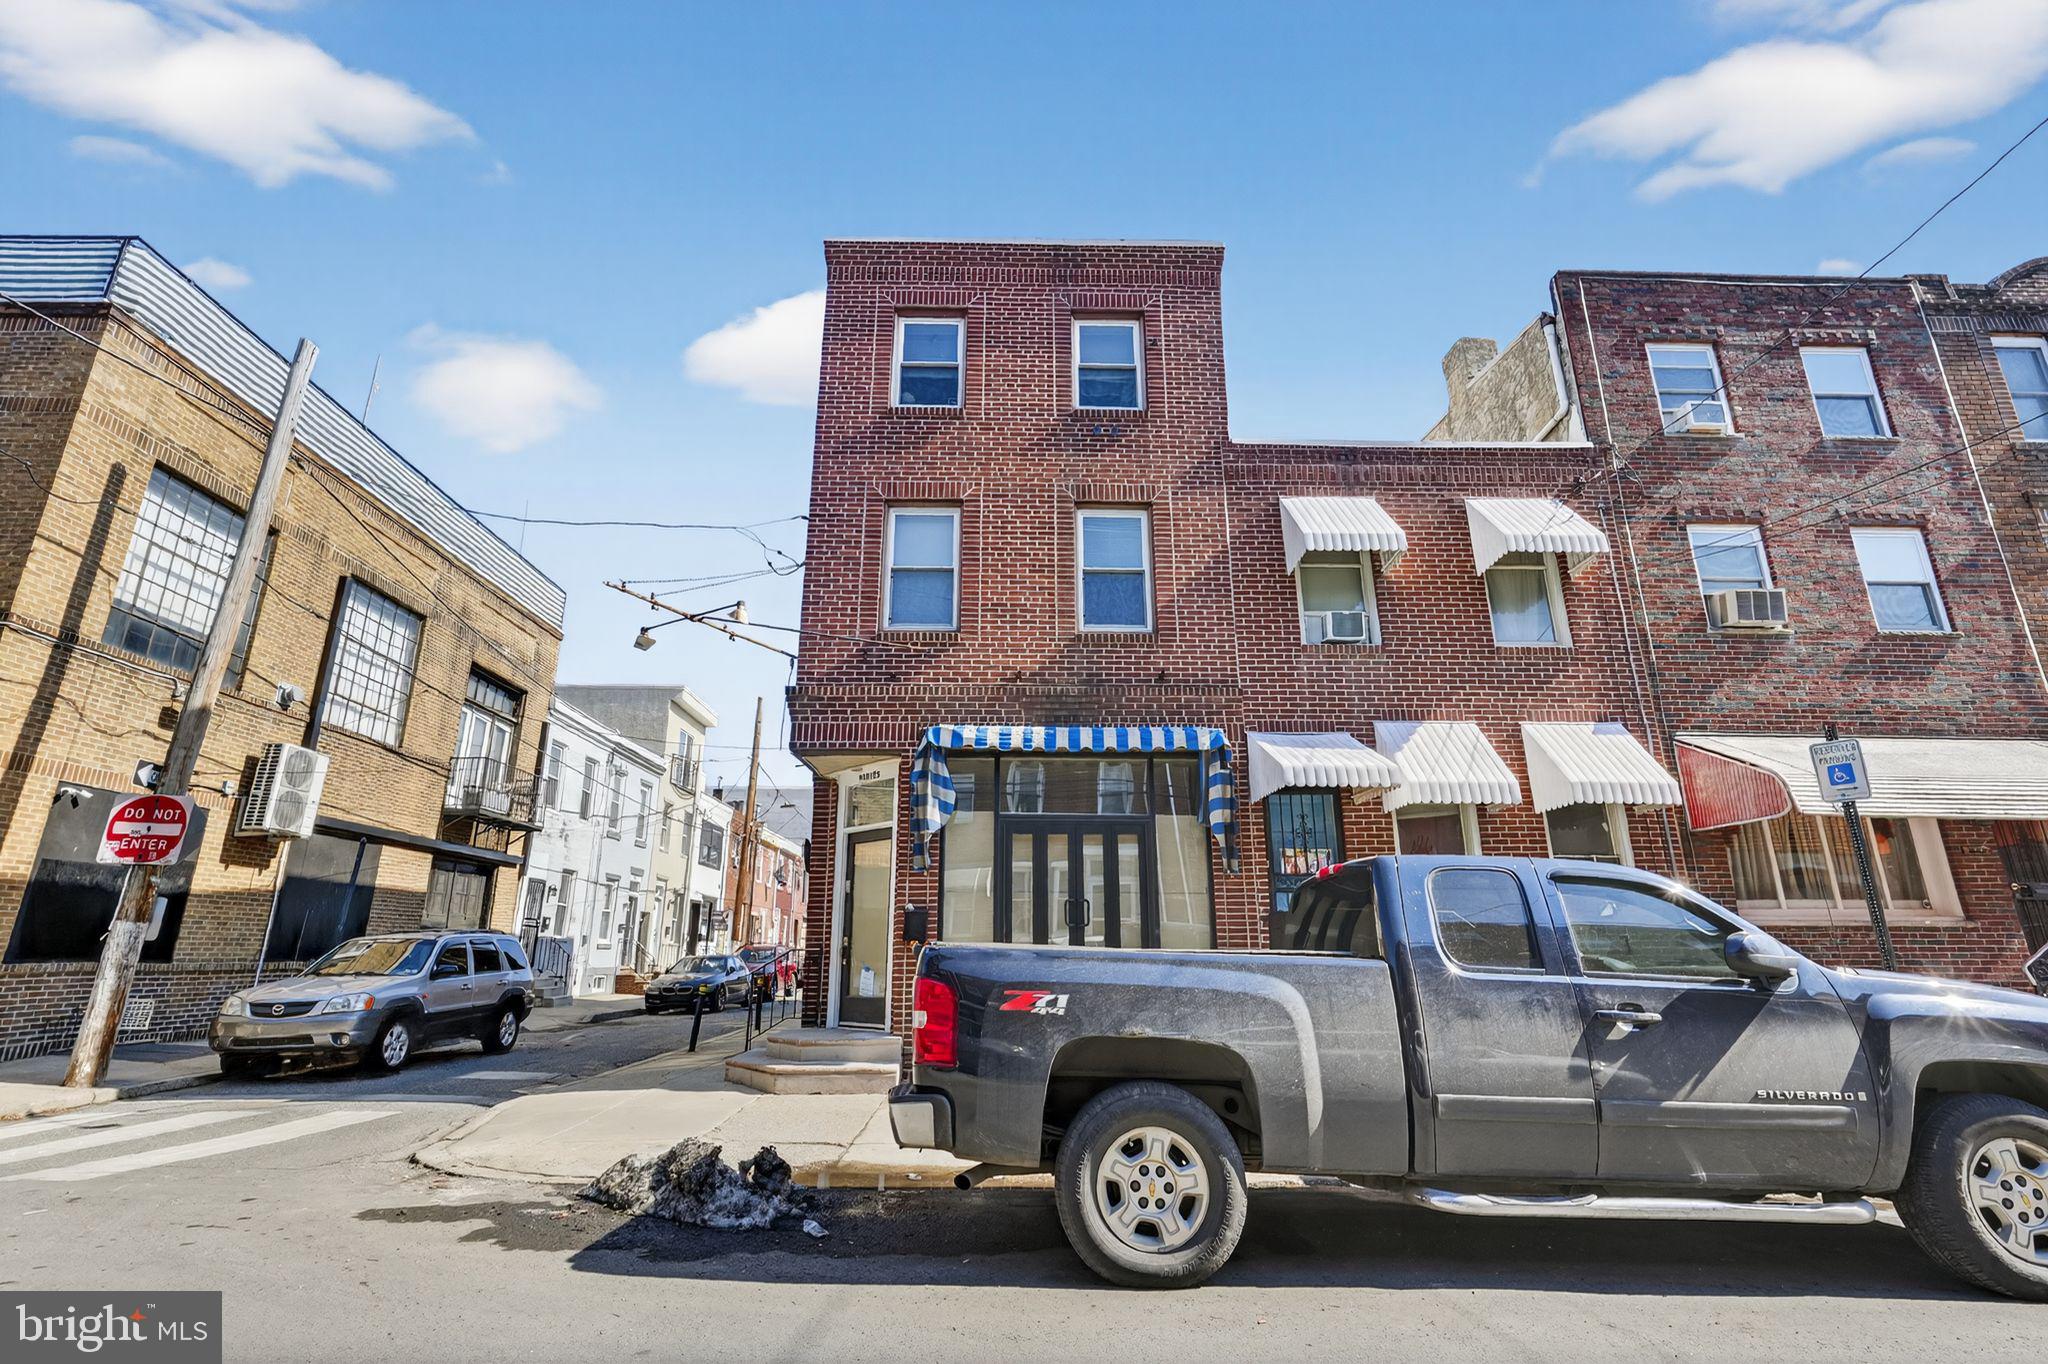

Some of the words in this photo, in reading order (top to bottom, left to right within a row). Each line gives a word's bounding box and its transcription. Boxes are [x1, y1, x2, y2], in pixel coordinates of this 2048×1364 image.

[124, 807, 145, 818] DO
[153, 808, 182, 820] NOT
[120, 838, 167, 850] ENTER
[999, 990, 1069, 1010] Z71
[1757, 1089, 1854, 1101] SILVERADO
